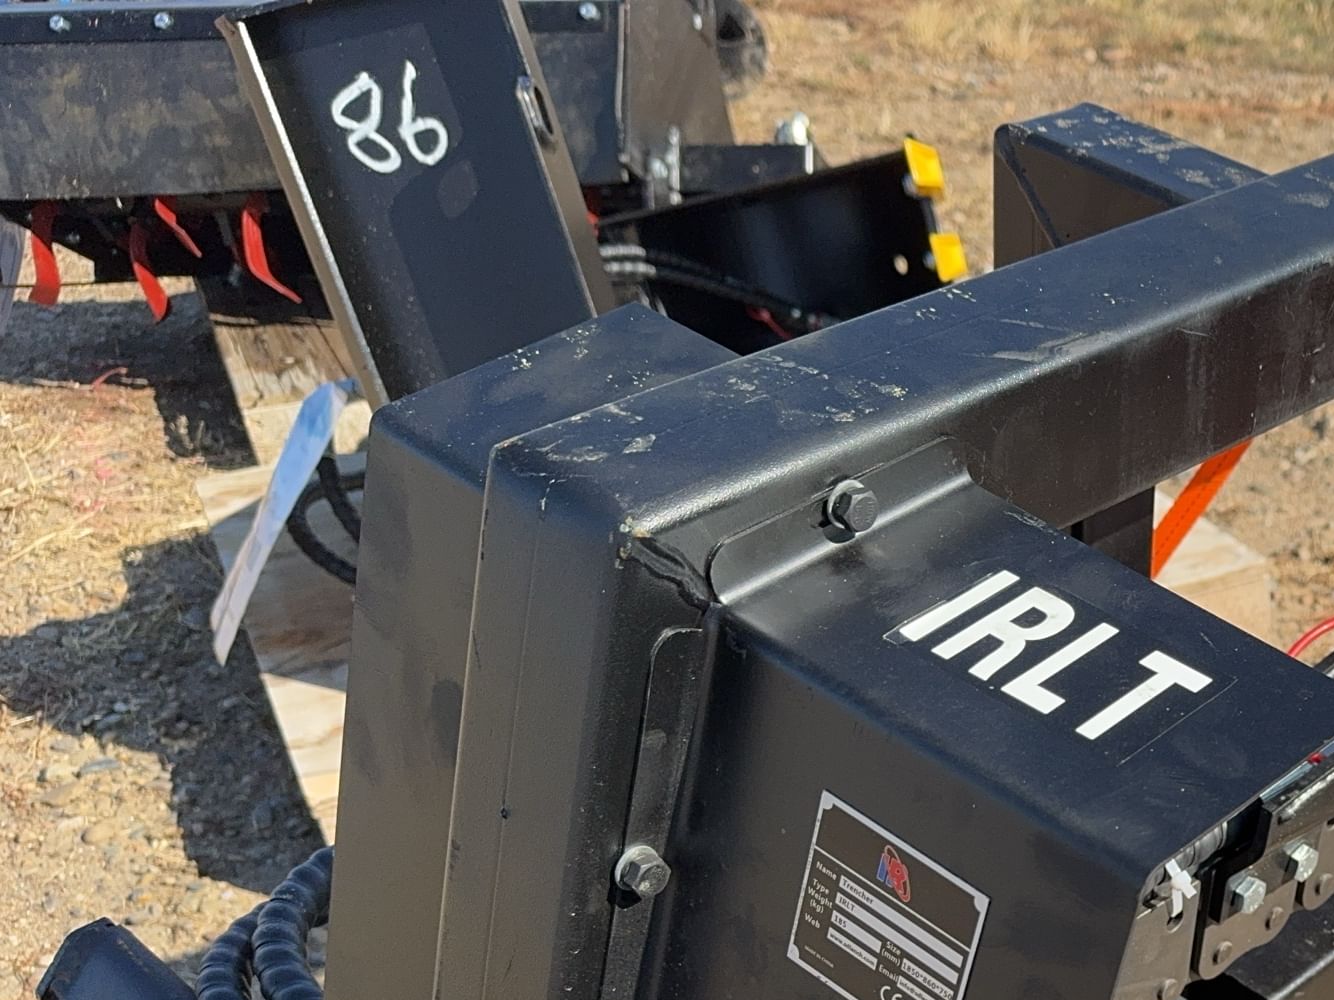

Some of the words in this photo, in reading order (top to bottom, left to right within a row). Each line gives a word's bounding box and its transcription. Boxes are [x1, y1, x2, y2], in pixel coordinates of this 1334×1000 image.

[331, 59, 448, 173] 86
[899, 570, 1213, 740] IRLT
[812, 878, 830, 897] Type
[839, 896, 855, 912] IRLT
[816, 861, 837, 880] Name
[843, 879, 874, 905] Trencher
[807, 886, 833, 910] Weight
[804, 912, 821, 929] Web
[809, 898, 824, 915] (kg)
[834, 915, 847, 928] 185
[881, 948, 901, 967] (mm)
[886, 941, 901, 956] Size
[879, 964, 898, 983] Email
